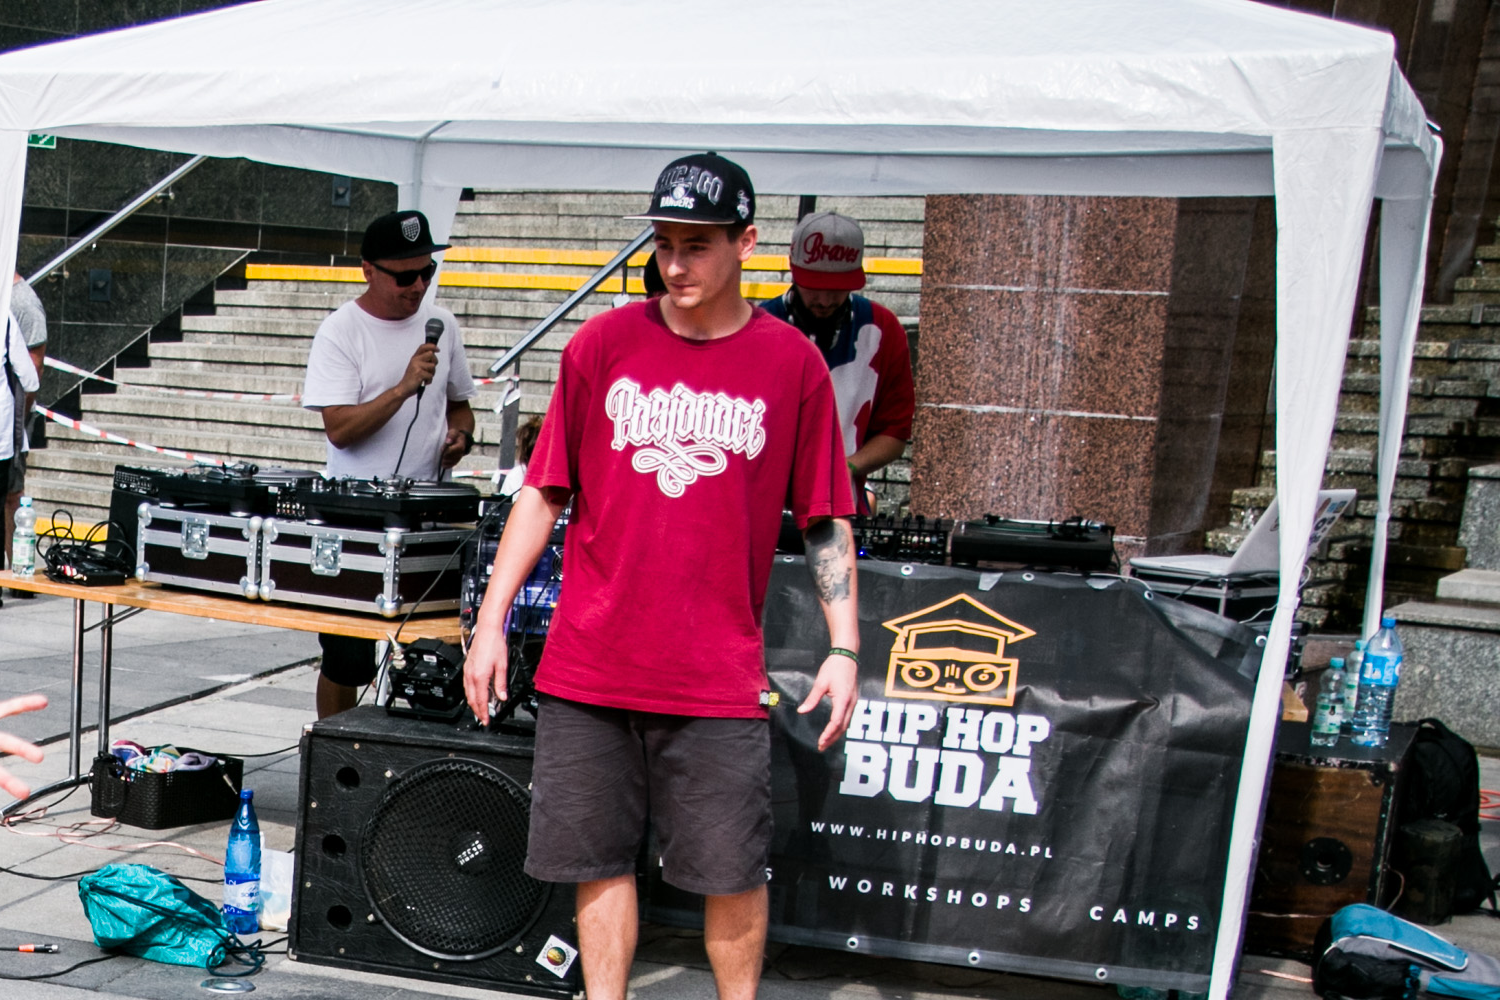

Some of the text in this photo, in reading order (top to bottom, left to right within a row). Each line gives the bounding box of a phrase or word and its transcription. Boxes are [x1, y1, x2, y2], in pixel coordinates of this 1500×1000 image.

[803, 231, 860, 264] Braves
[846, 699, 1051, 757] HIP HOP
[839, 741, 1038, 815] BUDA
[811, 821, 1053, 859] WWW.HIPHOPBUDA.PL
[828, 875, 1199, 931] WORKSHOPS CAMPS
